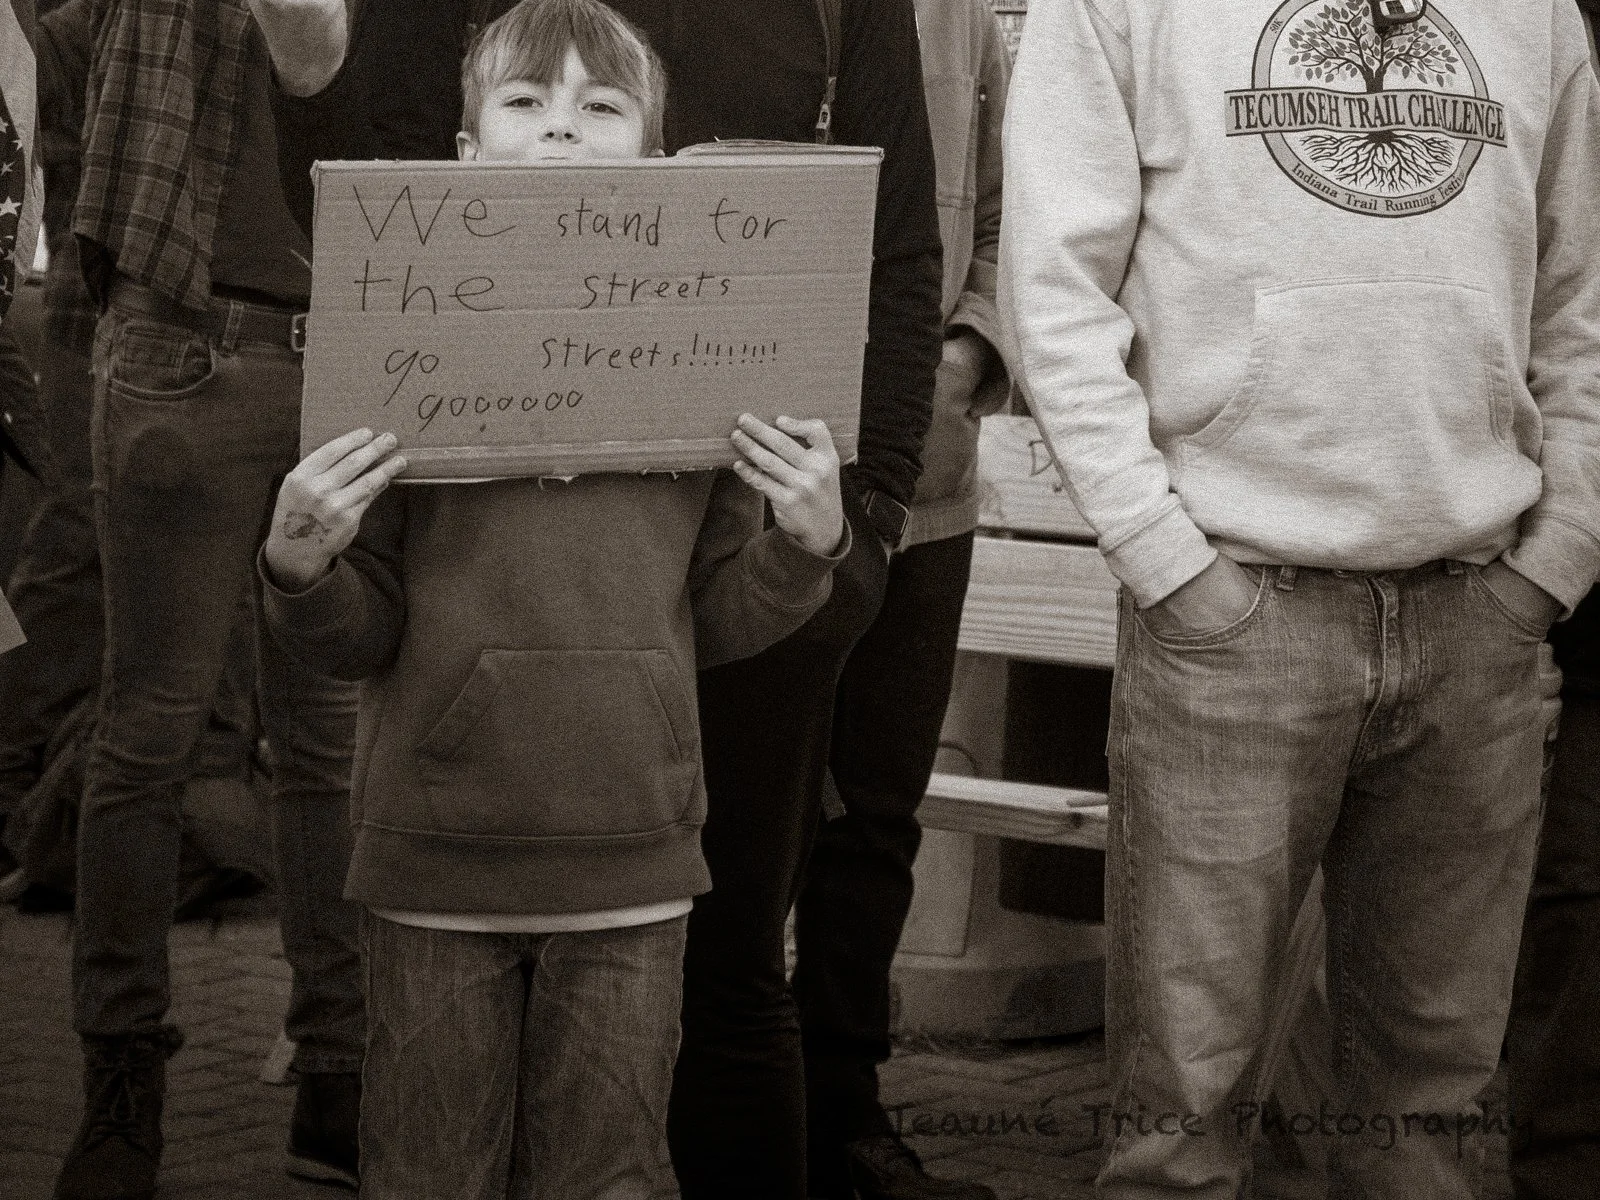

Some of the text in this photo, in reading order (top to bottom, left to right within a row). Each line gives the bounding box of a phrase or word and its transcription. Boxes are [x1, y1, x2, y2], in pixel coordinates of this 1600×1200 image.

[1229, 90, 1505, 141] TECUMSEH TRAIL CHALLENGE
[353, 184, 788, 247] We stand for
[1291, 162, 1338, 199] Indiana
[1344, 193, 1378, 211] Trail
[1385, 193, 1437, 212] Running
[352, 258, 506, 315] the
[383, 349, 440, 407] go
